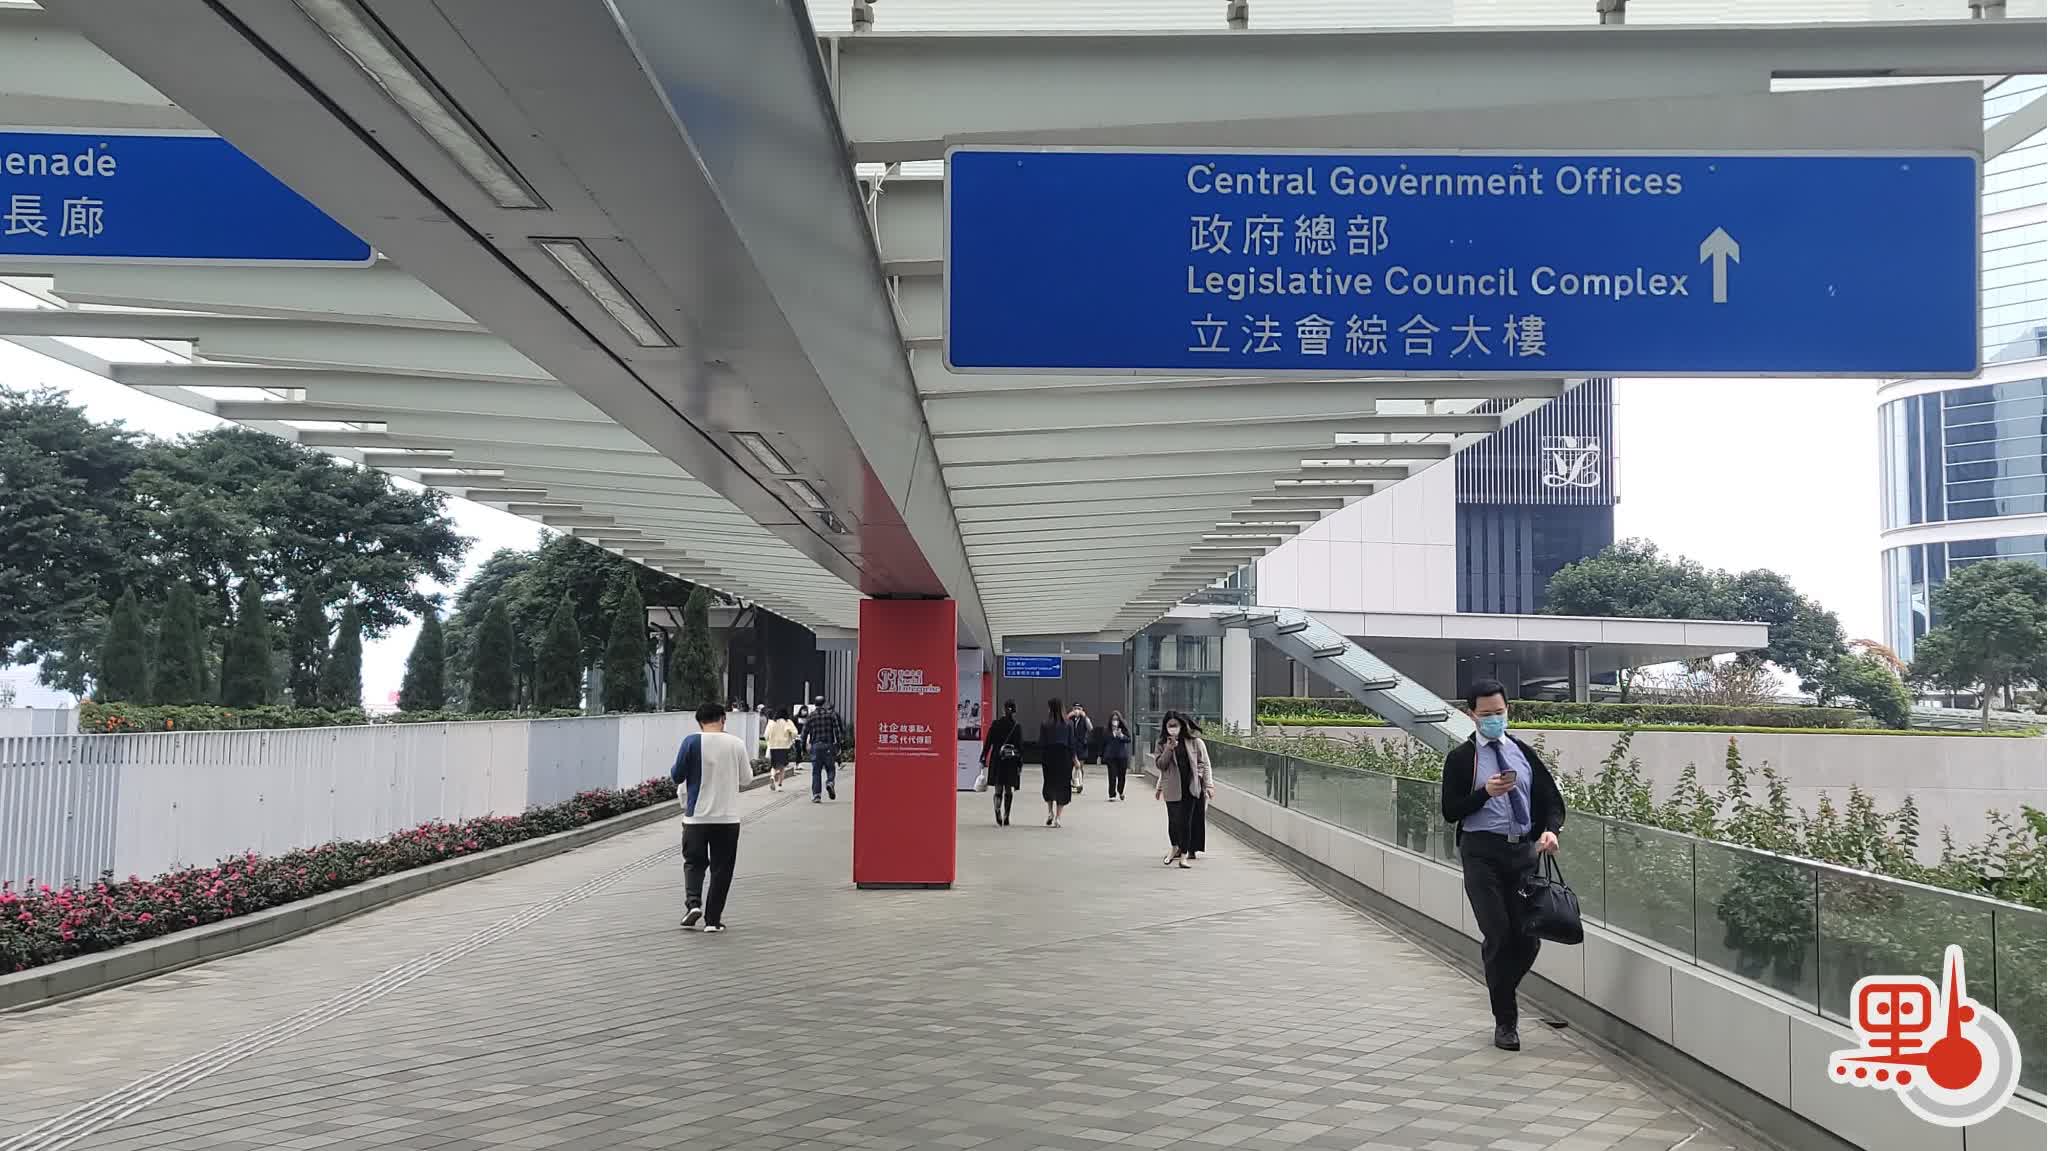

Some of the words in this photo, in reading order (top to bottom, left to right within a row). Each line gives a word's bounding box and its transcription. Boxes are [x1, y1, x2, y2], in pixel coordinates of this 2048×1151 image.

[0, 147, 117, 177] enade
[1187, 164, 1316, 195] Central
[1329, 164, 1543, 195] Government
[1555, 165, 1683, 195] Offices
[2, 194, 104, 238] 長廊
[1190, 213, 1389, 255] 政府總部
[1187, 264, 1373, 300] Legislative
[1384, 265, 1519, 297] Council
[1530, 265, 1690, 301] Complex
[1189, 312, 1547, 357] 立法會綜合大樓
